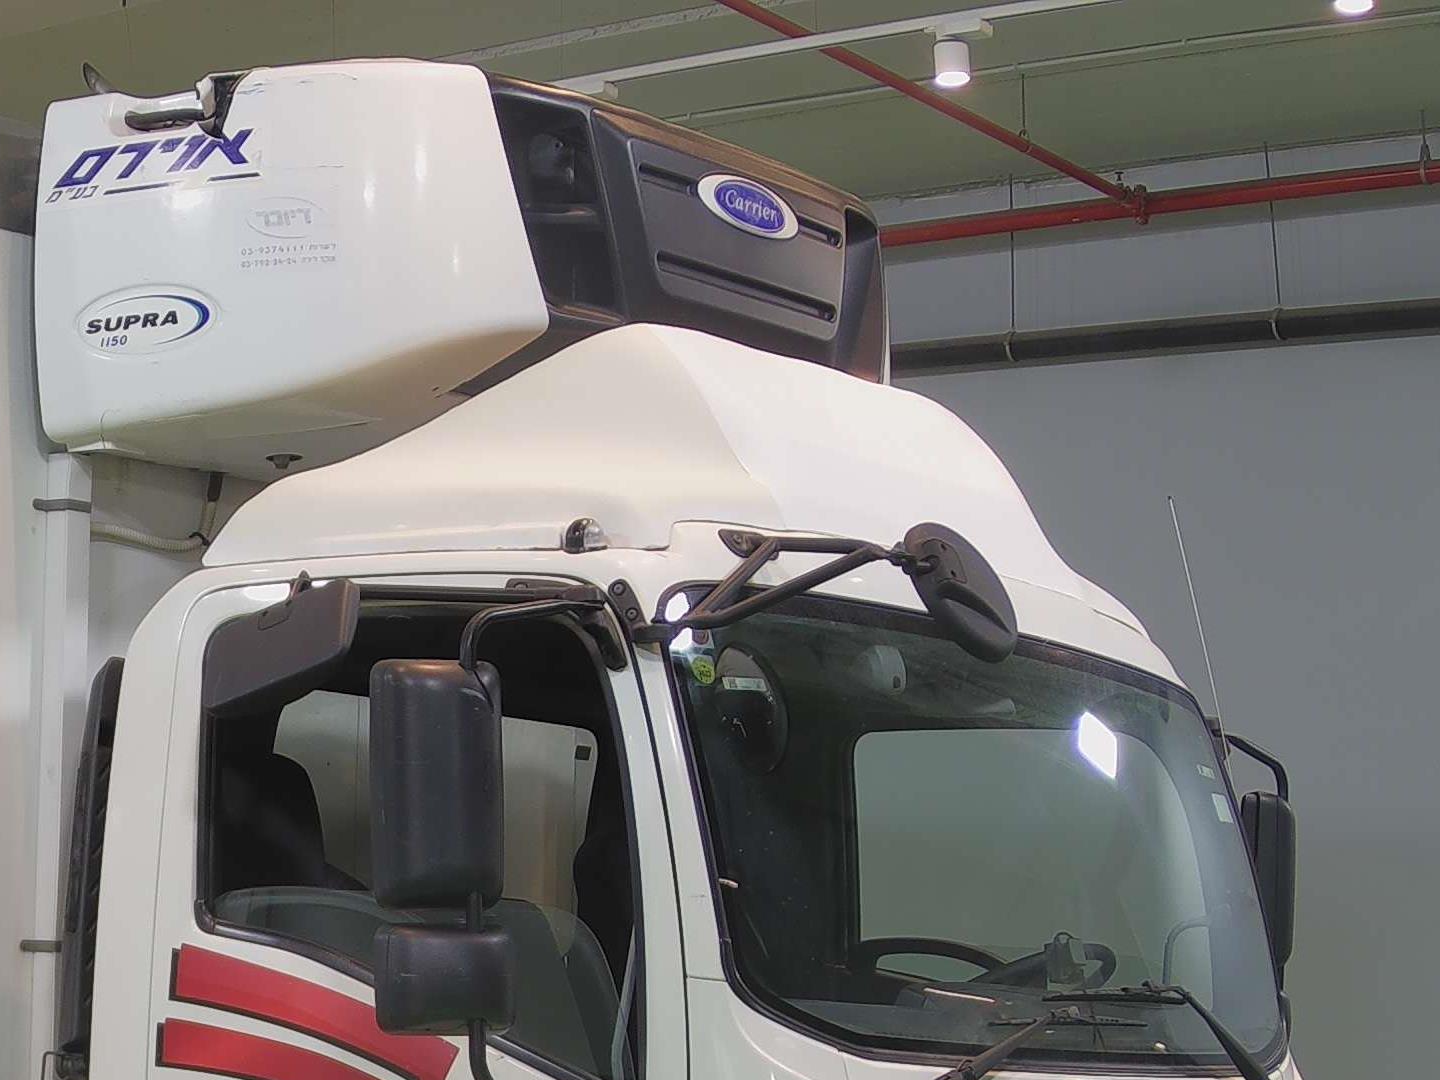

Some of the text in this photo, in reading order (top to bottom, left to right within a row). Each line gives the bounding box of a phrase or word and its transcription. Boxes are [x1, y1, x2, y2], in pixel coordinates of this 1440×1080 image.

[725, 189, 778, 222] Carrier
[85, 310, 179, 335] SUPRA
[100, 334, 128, 348] 1150
